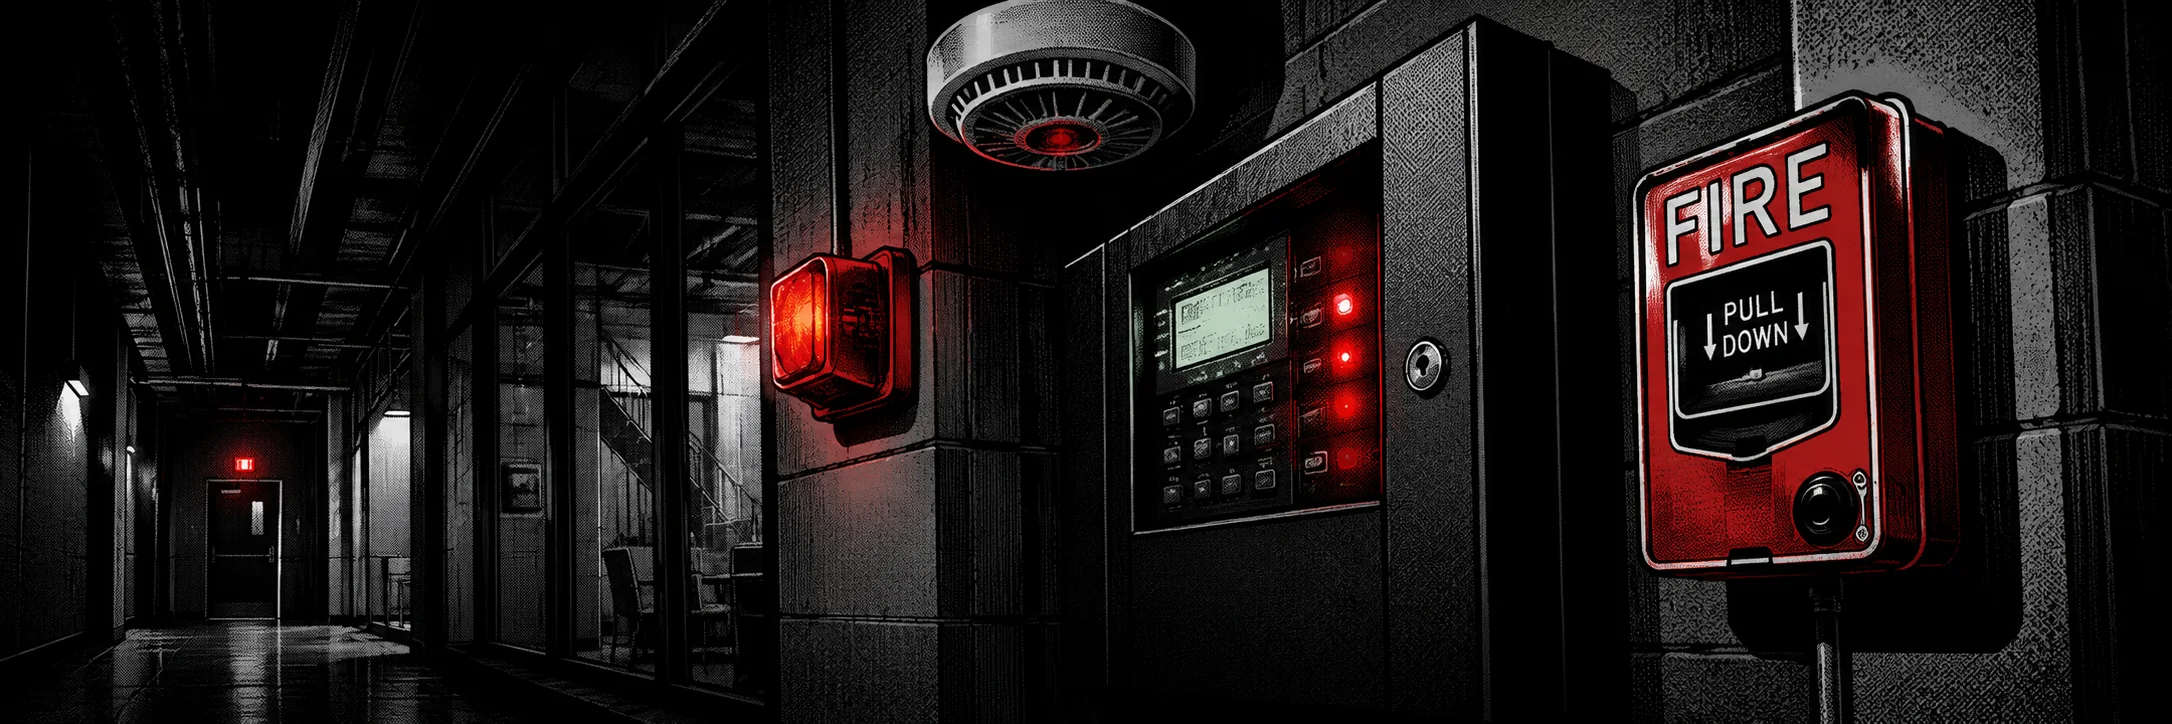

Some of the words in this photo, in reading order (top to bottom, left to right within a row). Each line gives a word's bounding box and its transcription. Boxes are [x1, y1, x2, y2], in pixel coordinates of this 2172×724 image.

[1666, 143, 1829, 266] FIRE
[1724, 290, 1784, 326] PULL
[1723, 320, 1788, 358] DOWN
